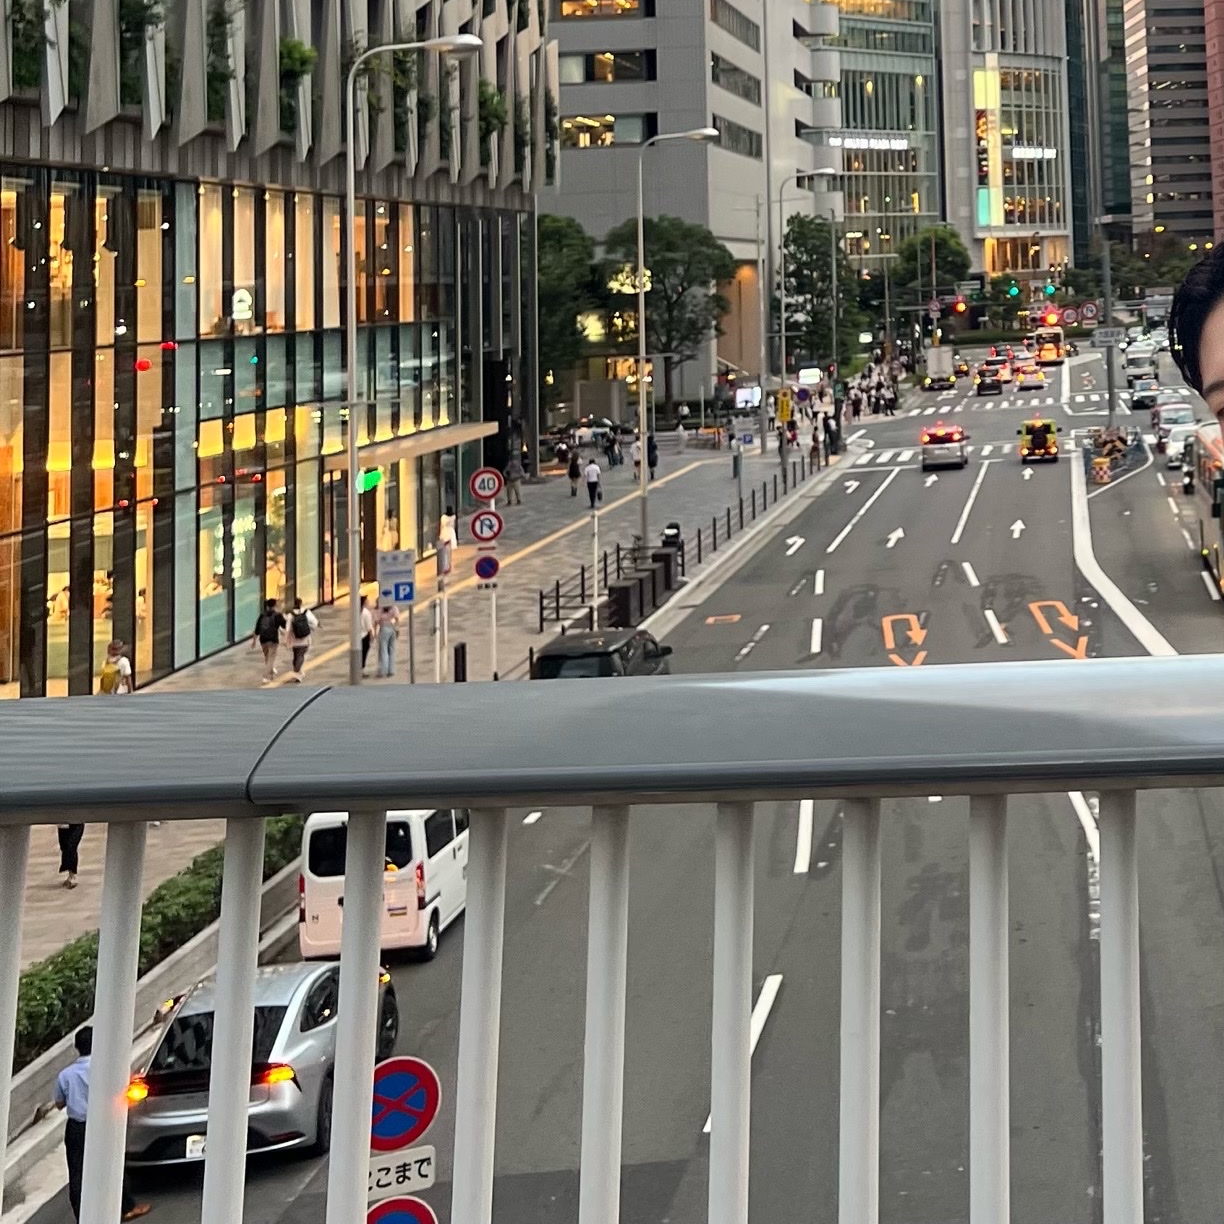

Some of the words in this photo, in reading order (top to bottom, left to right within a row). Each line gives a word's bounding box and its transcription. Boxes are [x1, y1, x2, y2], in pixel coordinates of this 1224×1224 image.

[477, 477, 496, 492] 40
[368, 1157, 432, 1192] こまで
